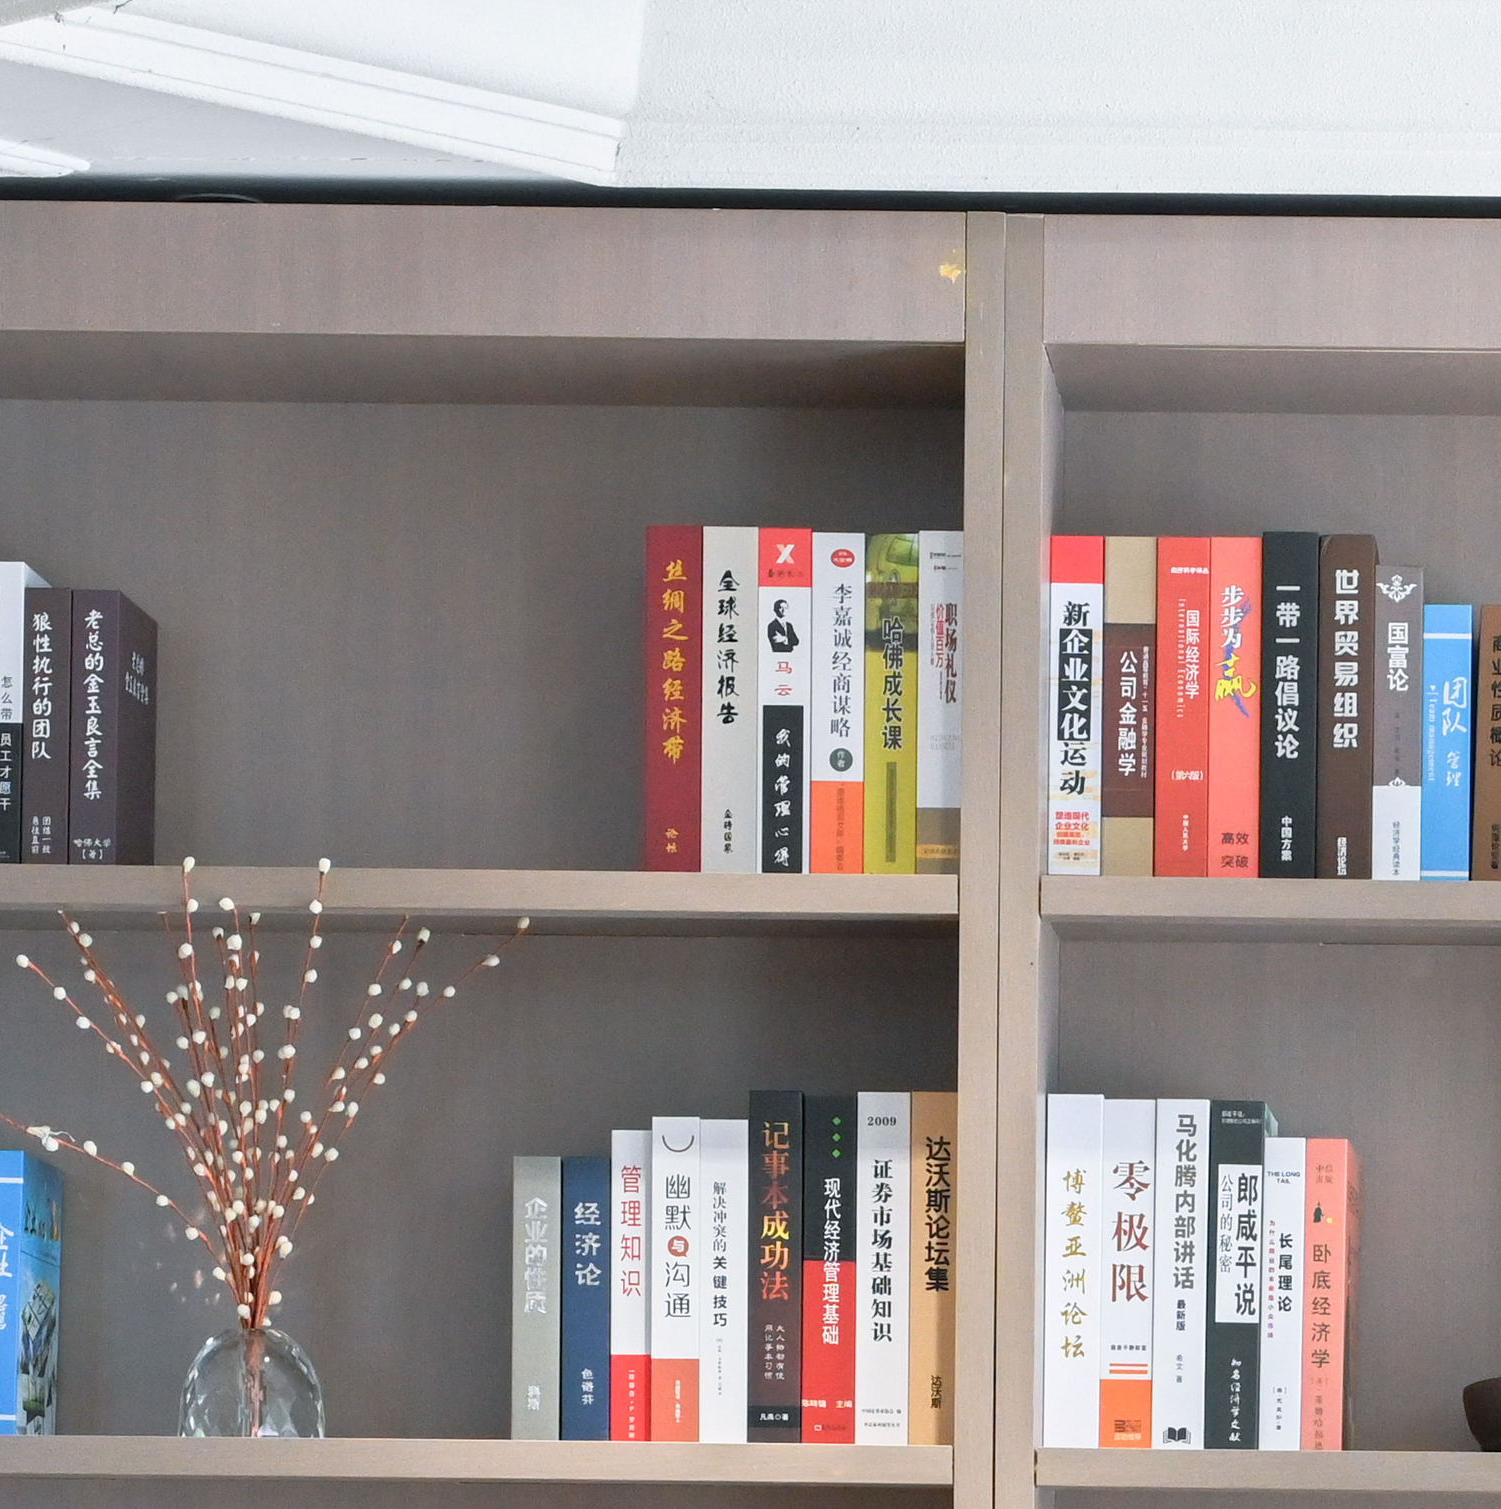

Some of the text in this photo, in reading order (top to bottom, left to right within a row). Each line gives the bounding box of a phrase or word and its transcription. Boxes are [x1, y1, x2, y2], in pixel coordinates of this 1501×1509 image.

[0, 675, 13, 720] 怎么带
[716, 570, 740, 724] 全球经济报告
[831, 583, 853, 738] 李嘉诚经商谋略
[881, 616, 904, 750] 哈佛成长课
[935, 604, 945, 669] 价值百万
[1185, 609, 1200, 699] 国际经济学
[1333, 569, 1360, 748] 世界贸易组织
[1387, 622, 1409, 692] 国富论
[1117, 650, 1139, 777] 公司金融学
[73, 838, 111, 847] 哈佛大学
[1055, 822, 1089, 831] 企业文化
[1221, 832, 1249, 845] 高效
[1221, 855, 1249, 868] 突破
[1281, 815, 1293, 862] 中国方案
[867, 1116, 897, 1127] 2009
[574, 1201, 602, 1287] 经济论
[620, 1164, 642, 1297] 管理知识
[665, 1173, 692, 1318] 幽默与沟通
[712, 1181, 728, 1327] 解决冲突的关键技巧
[760, 1121, 791, 1301] 记事本成功法
[822, 1177, 842, 1345] 现代经济管理基础
[870, 1159, 894, 1342] 证券市场基础知识
[924, 1135, 952, 1292] 达沃斯论坛集
[1111, 1160, 1151, 1303] 零极限
[1173, 1114, 1198, 1290] 马化腾内部讲话
[1235, 1172, 1259, 1317] 郎咸平说
[1175, 1299, 1187, 1331] 最新版
[1278, 1232, 1293, 1313] 长尾理论
[1312, 1243, 1332, 1369] 卧底经济学
[930, 1375, 942, 1409] 达沃斯
